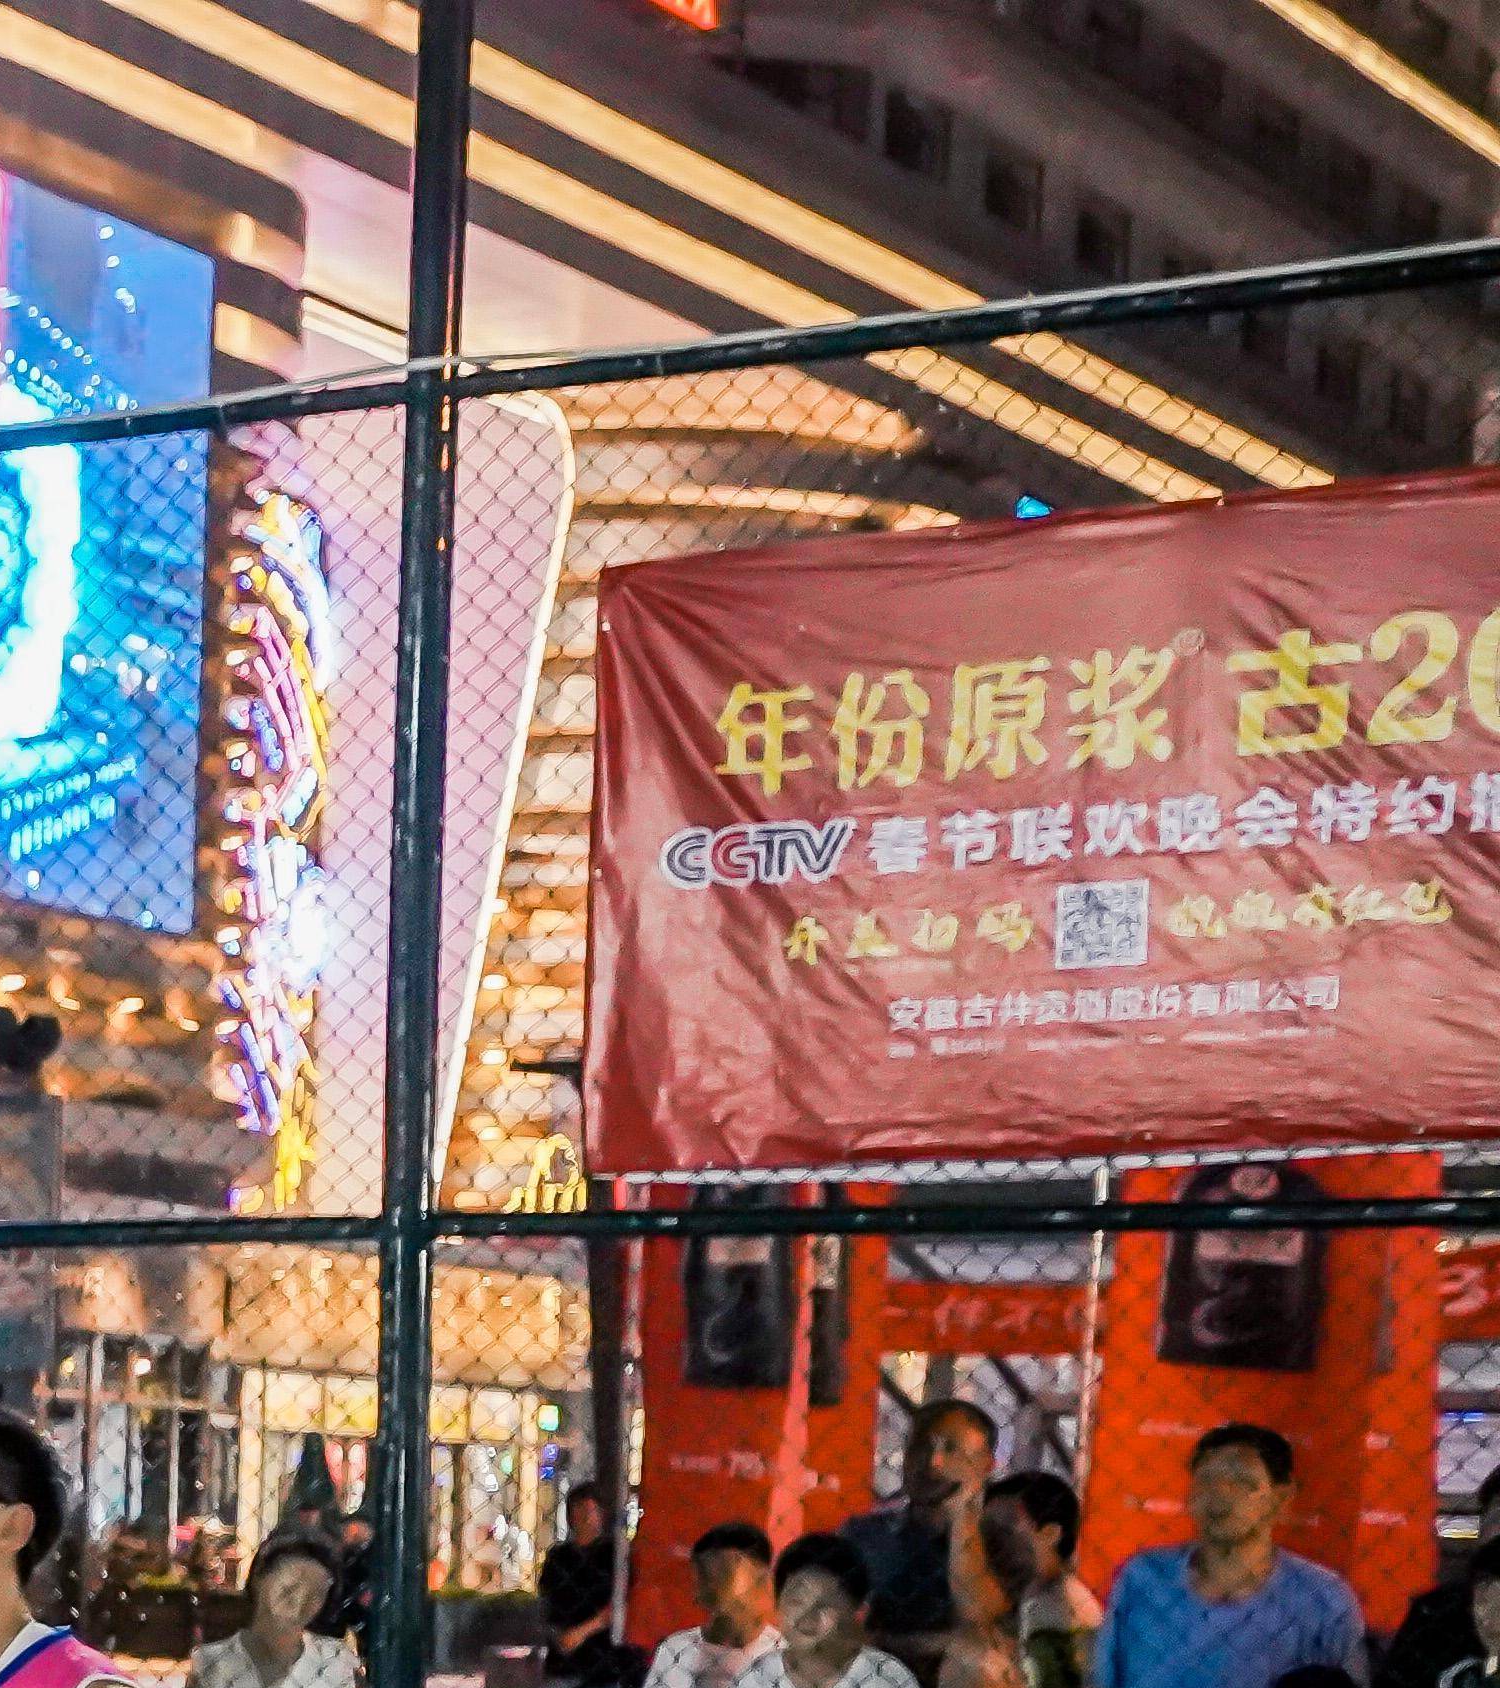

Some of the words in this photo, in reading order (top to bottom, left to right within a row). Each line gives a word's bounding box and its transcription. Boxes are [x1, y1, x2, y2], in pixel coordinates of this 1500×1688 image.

[715, 646, 1176, 796] 年份原浆
[658, 817, 860, 891] CCTV
